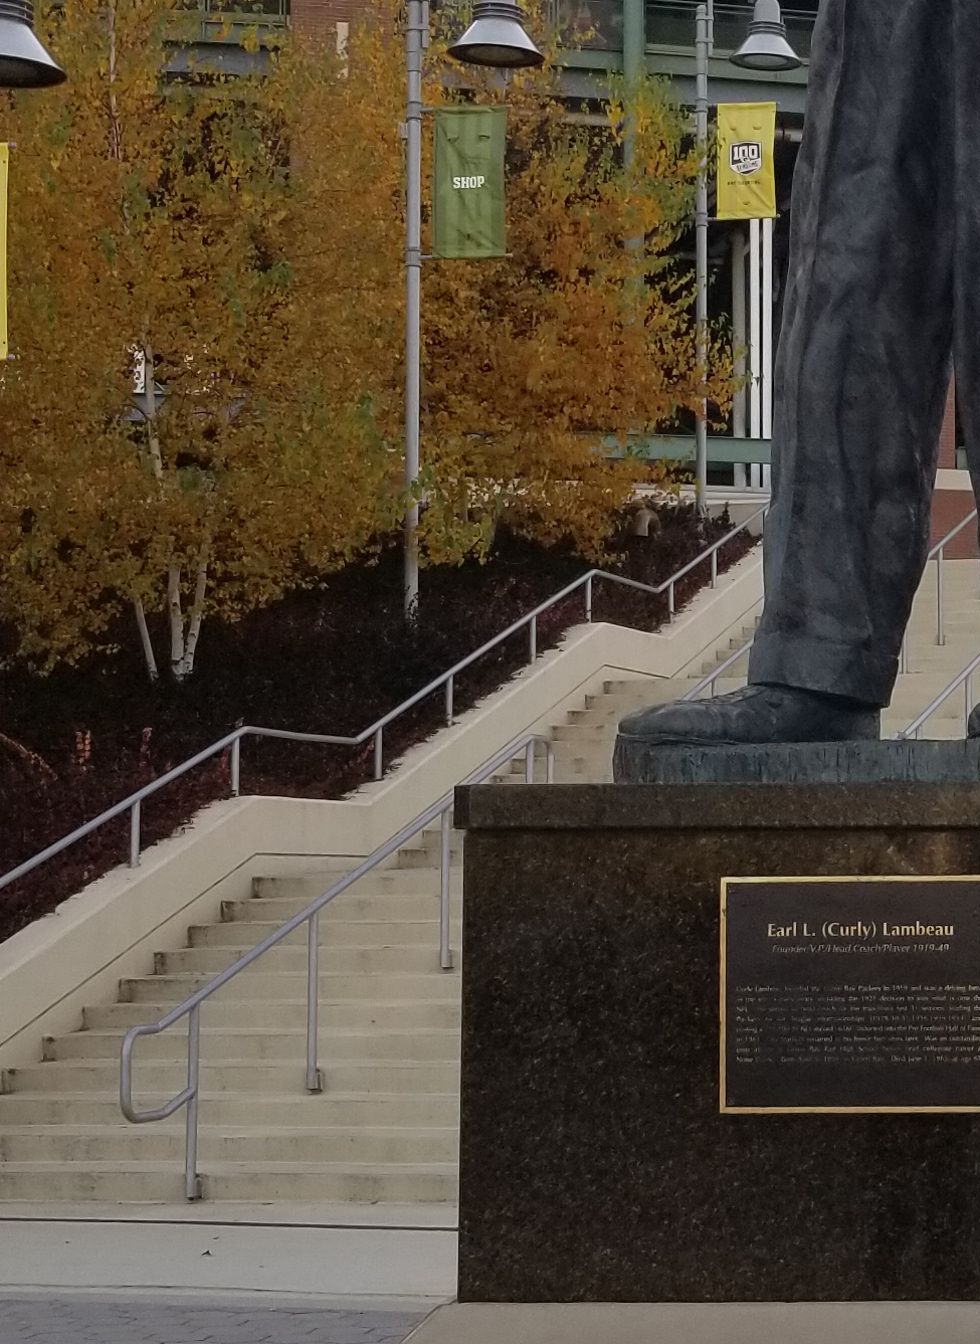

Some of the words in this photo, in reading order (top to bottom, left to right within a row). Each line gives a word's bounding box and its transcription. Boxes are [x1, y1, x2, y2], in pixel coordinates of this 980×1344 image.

[733, 145, 759, 161] 100
[453, 175, 485, 189] SHOP
[767, 922, 797, 937] Earl
[803, 923, 816, 937] L.
[821, 921, 877, 940] (Curly)
[883, 921, 955, 937] Lambeau
